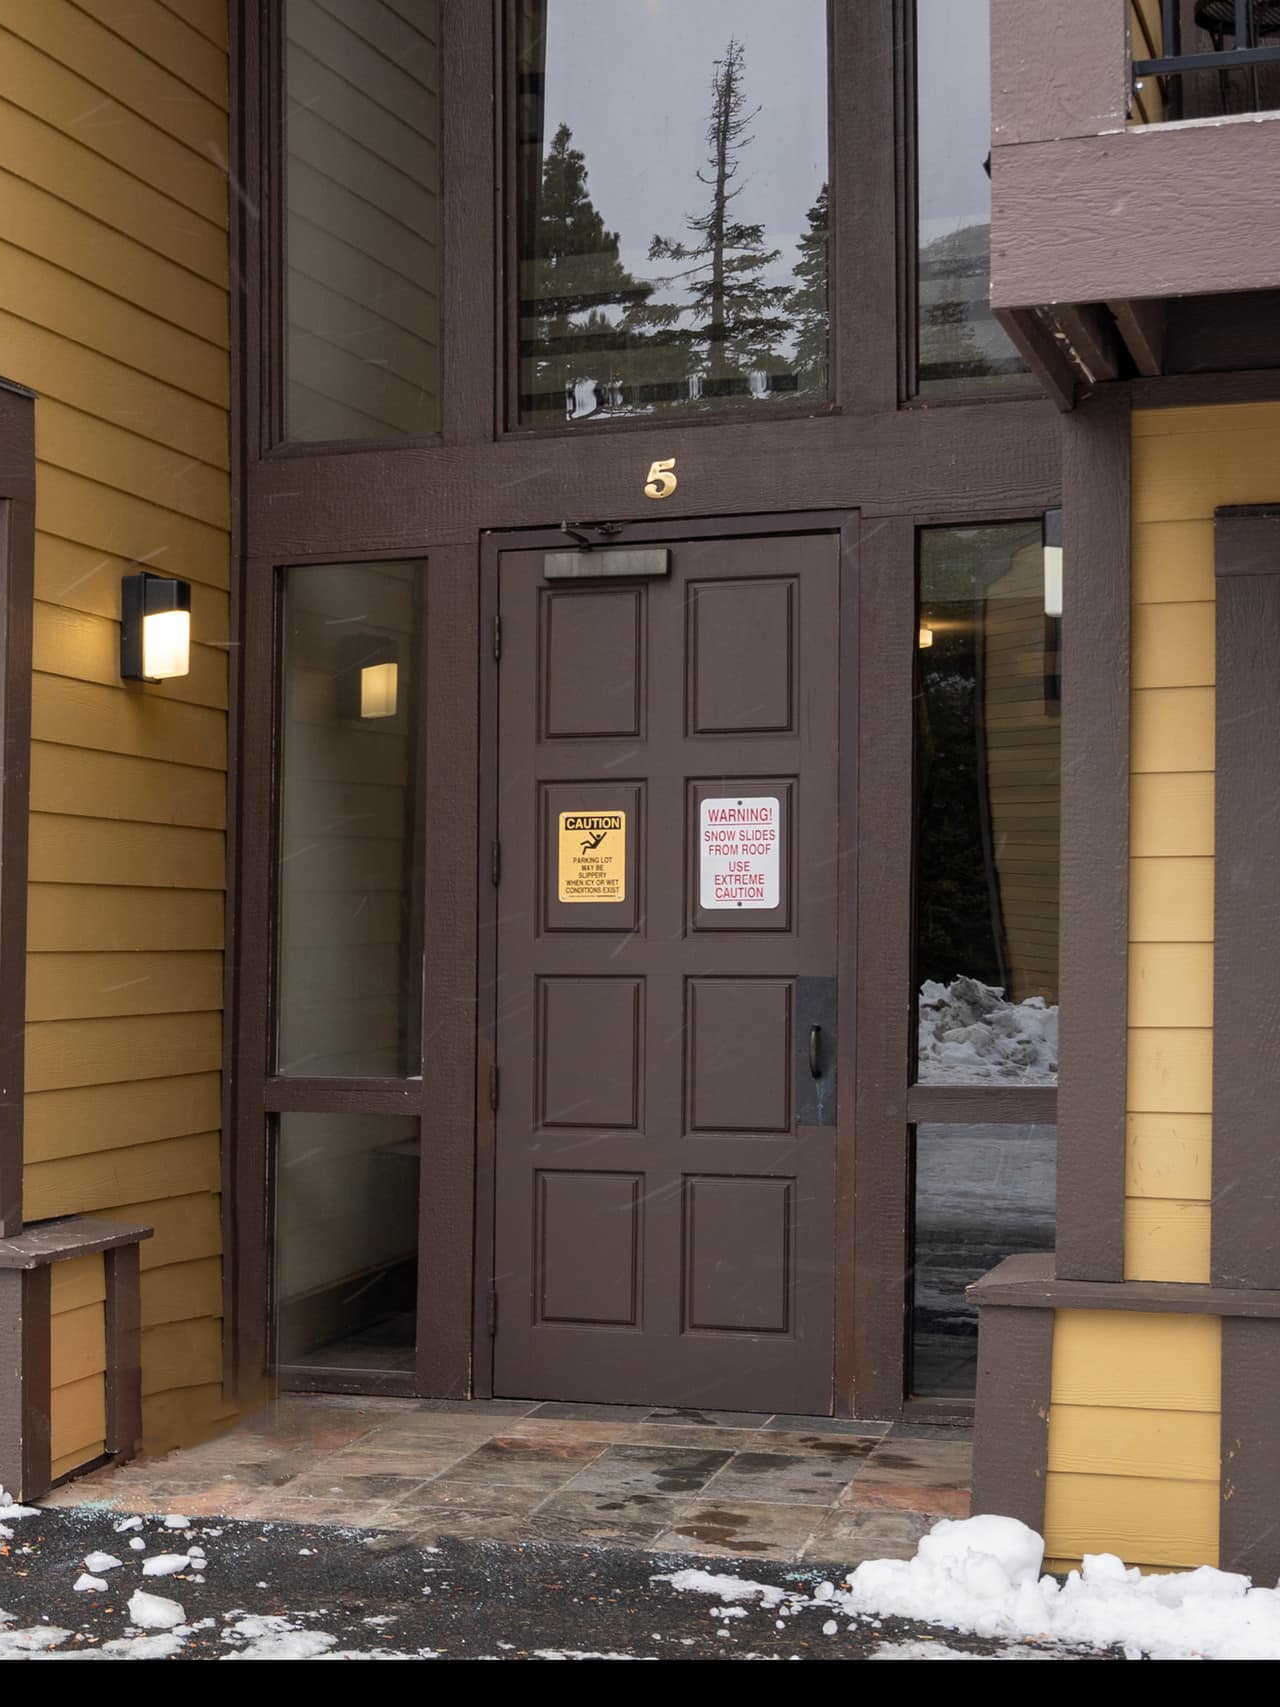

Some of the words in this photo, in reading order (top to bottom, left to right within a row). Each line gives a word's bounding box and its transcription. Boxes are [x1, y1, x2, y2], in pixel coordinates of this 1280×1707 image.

[644, 457, 677, 499] 5
[708, 807, 773, 822] WARNING!
[566, 818, 620, 829] CAUTION
[704, 831, 736, 842] SNOW
[739, 829, 776, 841] SLIDES
[708, 844, 738, 856] FROM
[742, 843, 772, 855] ROOF
[728, 861, 751, 872] USE
[714, 874, 765, 885] EXTREME
[715, 887, 764, 898] CAUTION
